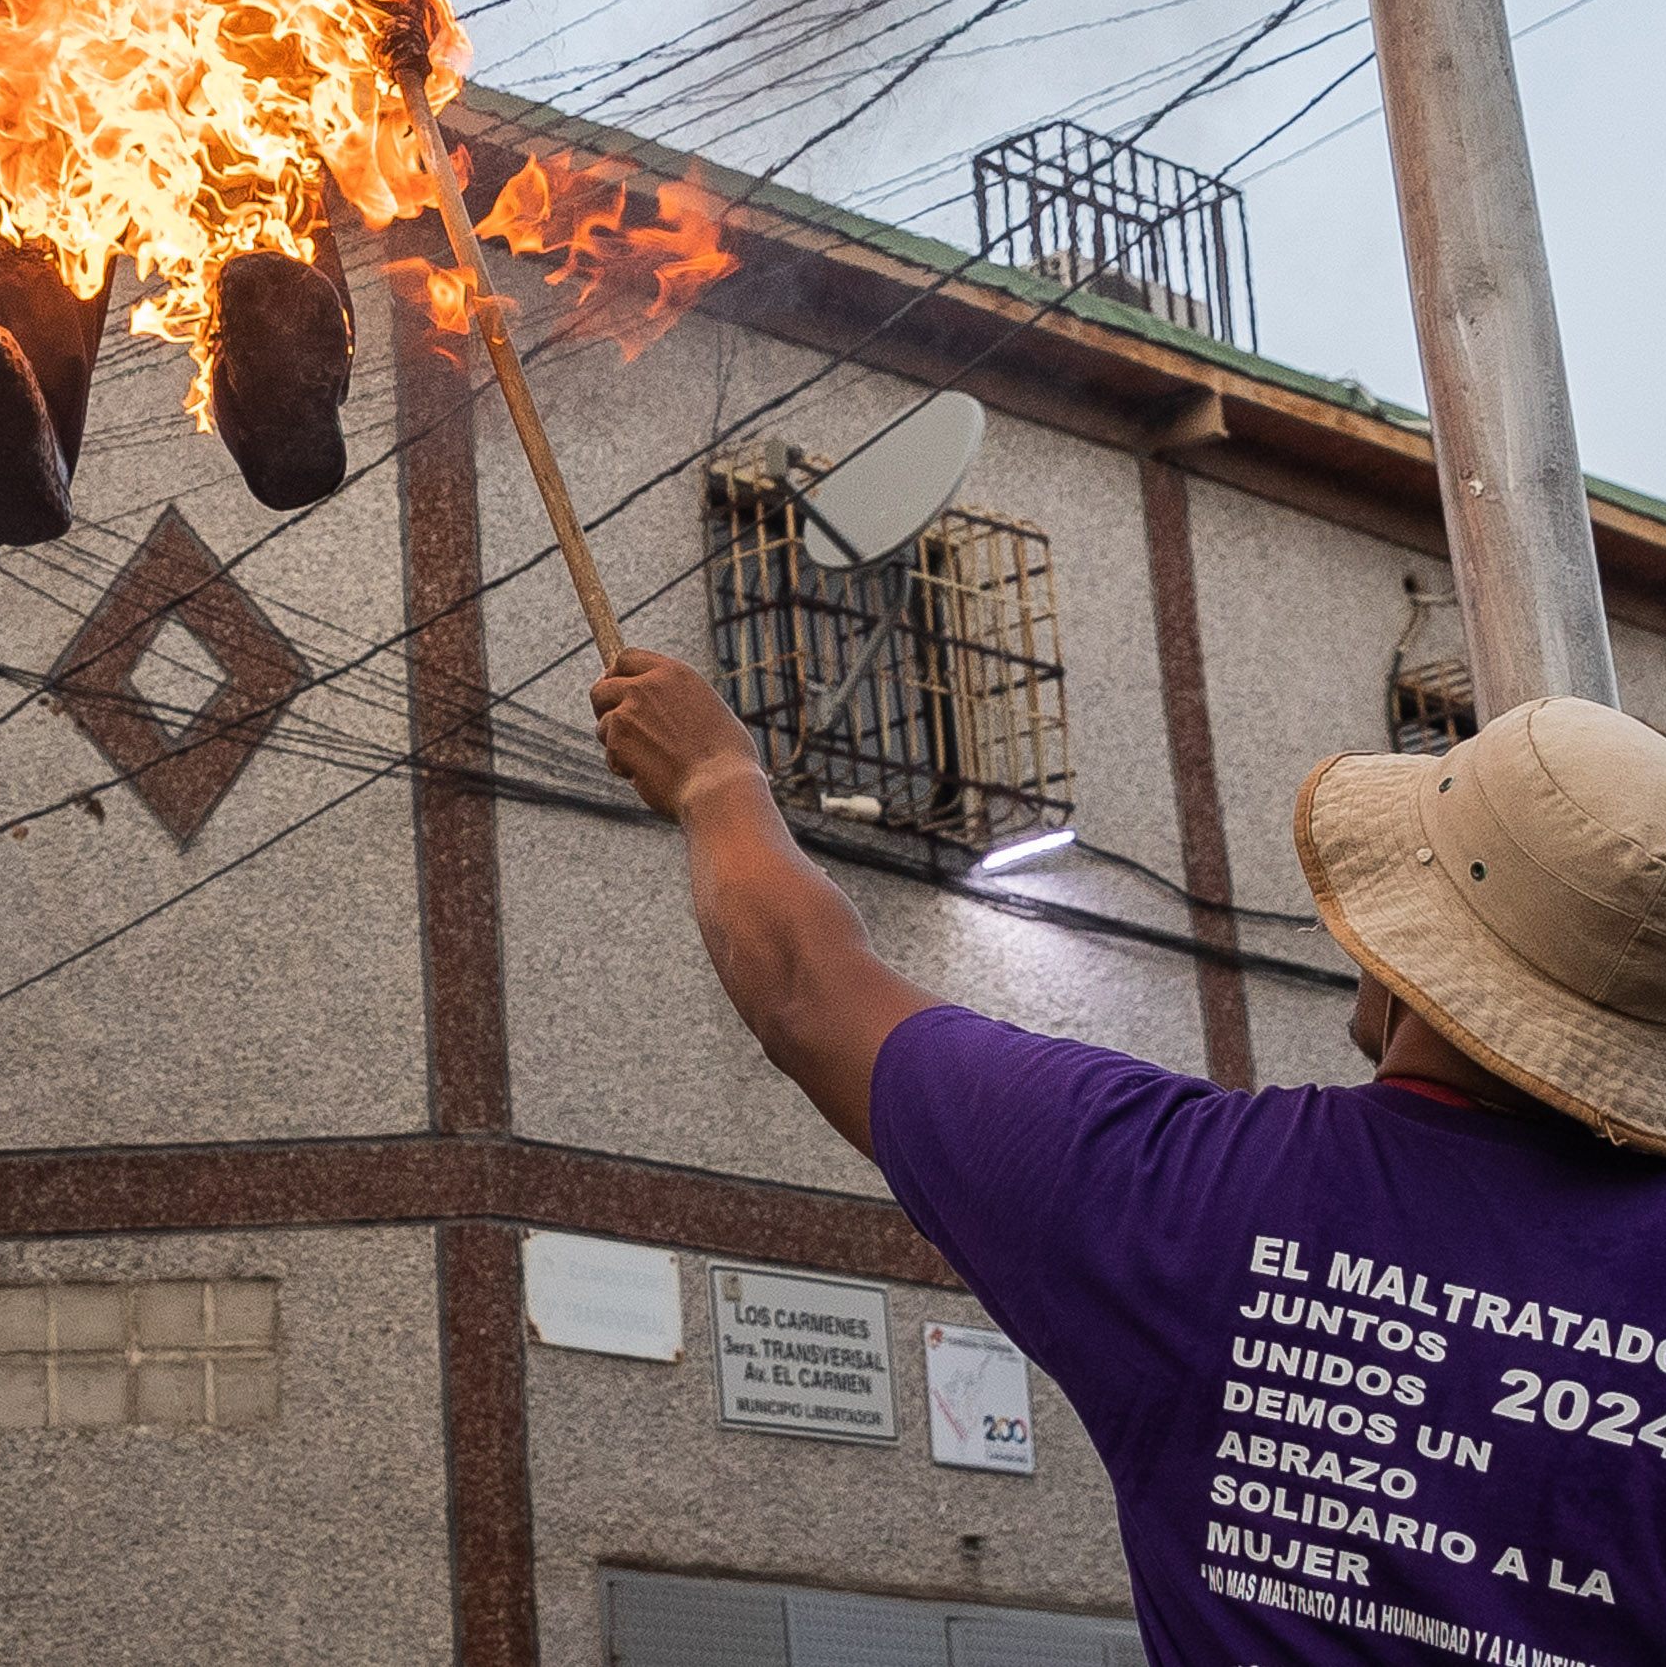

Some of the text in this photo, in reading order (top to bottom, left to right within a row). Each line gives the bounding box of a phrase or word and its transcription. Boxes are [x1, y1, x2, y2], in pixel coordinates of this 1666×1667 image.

[1250, 1236, 1309, 1281] EL
[734, 1301, 871, 1341] LOS CARMENES
[1240, 1291, 1447, 1362] JUNTOS
[760, 1337, 885, 1372] TRANSVERSAL
[772, 1364, 795, 1386] EL
[798, 1367, 873, 1395] CARMEN
[1233, 1337, 1426, 1405] UNIDOS
[984, 1414, 1027, 1444] 200
[1223, 1381, 1492, 1472] DEMOS UN
[1216, 1431, 1416, 1499] ABRAZO
[1207, 1522, 1369, 1586] MUJER
[1211, 1475, 1614, 1604] SOLIDARIO A LA
[1226, 1569, 1257, 1602] MAS
[1258, 1577, 1335, 1622] MALTRATO
[1338, 1597, 1351, 1626] A
[1355, 1599, 1376, 1631] LA
[1380, 1604, 1470, 1655] HUMANIDAD
[1475, 1631, 1488, 1660] Y
[1487, 1636, 1501, 1664] A
[1505, 1639, 1526, 1667] LA
